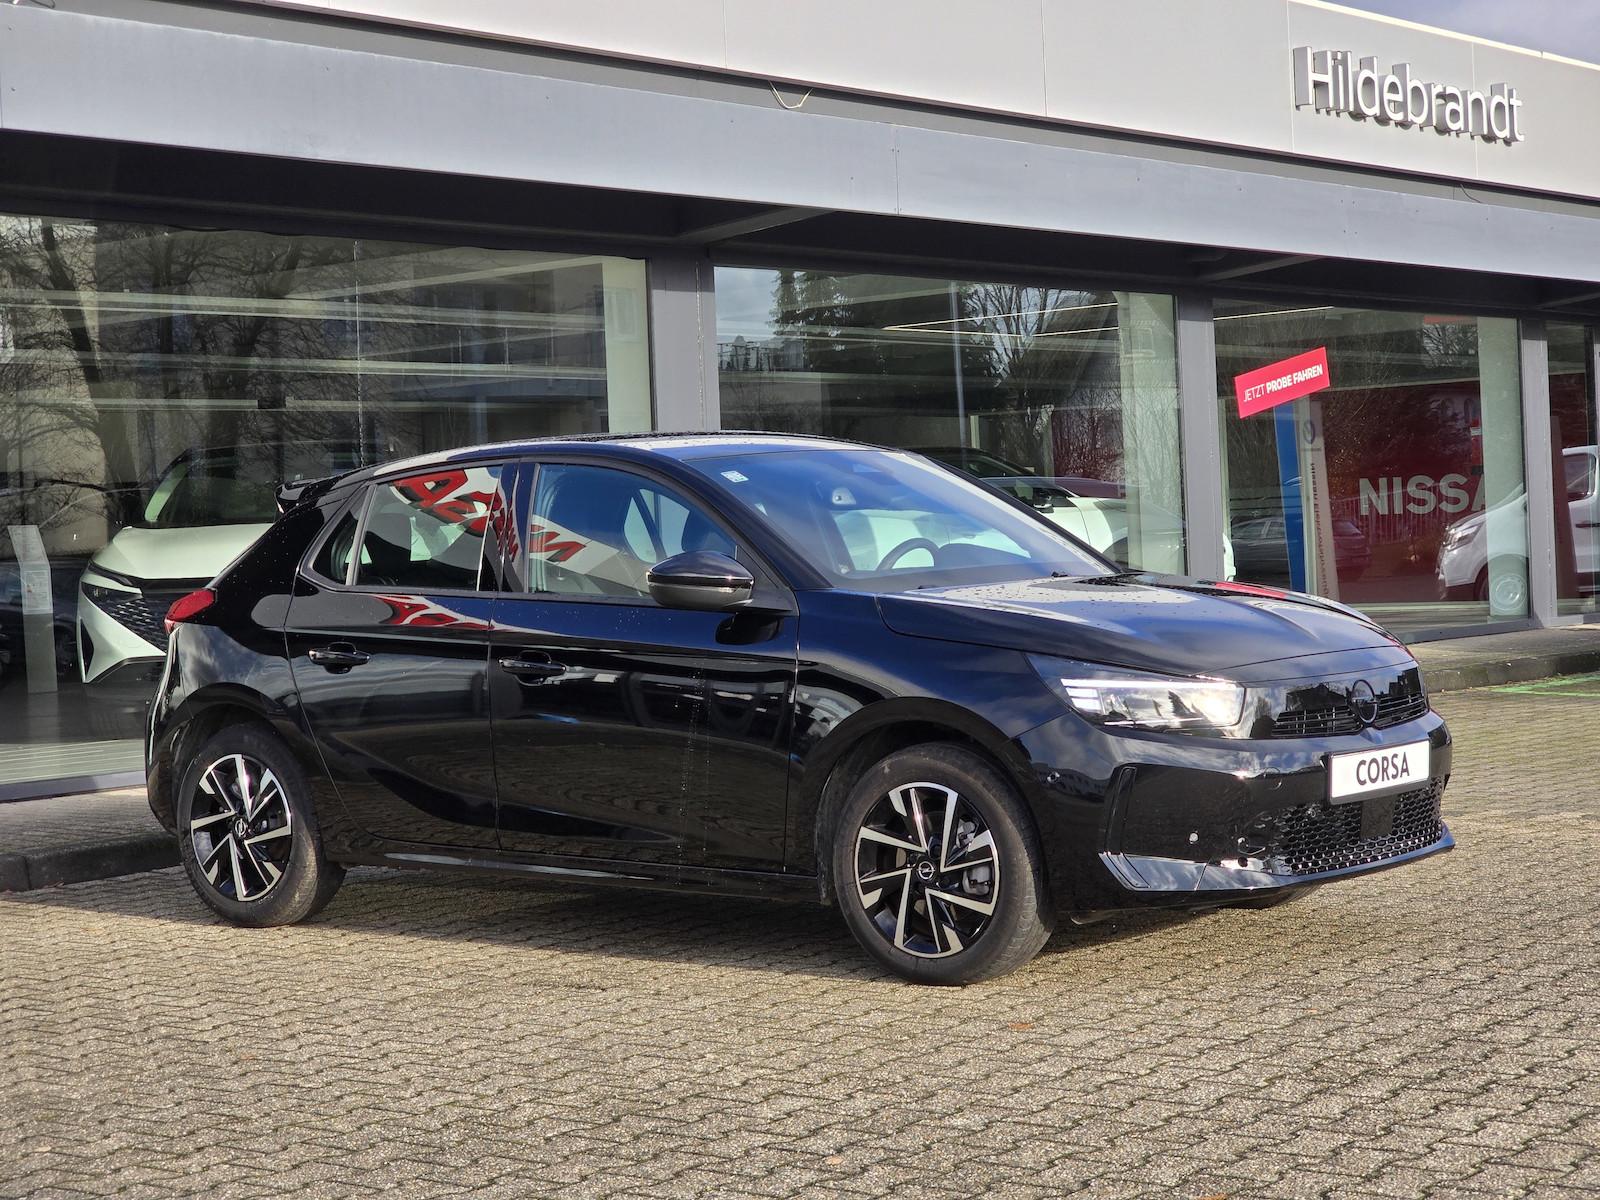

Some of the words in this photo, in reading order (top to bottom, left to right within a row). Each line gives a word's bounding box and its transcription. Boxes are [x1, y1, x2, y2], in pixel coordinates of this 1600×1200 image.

[1293, 46, 1525, 143] Hildebrandt
[1243, 383, 1265, 402] JETZT
[1265, 374, 1293, 394] PROBE
[1293, 364, 1324, 385] FAHREN
[1356, 751, 1410, 786] CORSA
